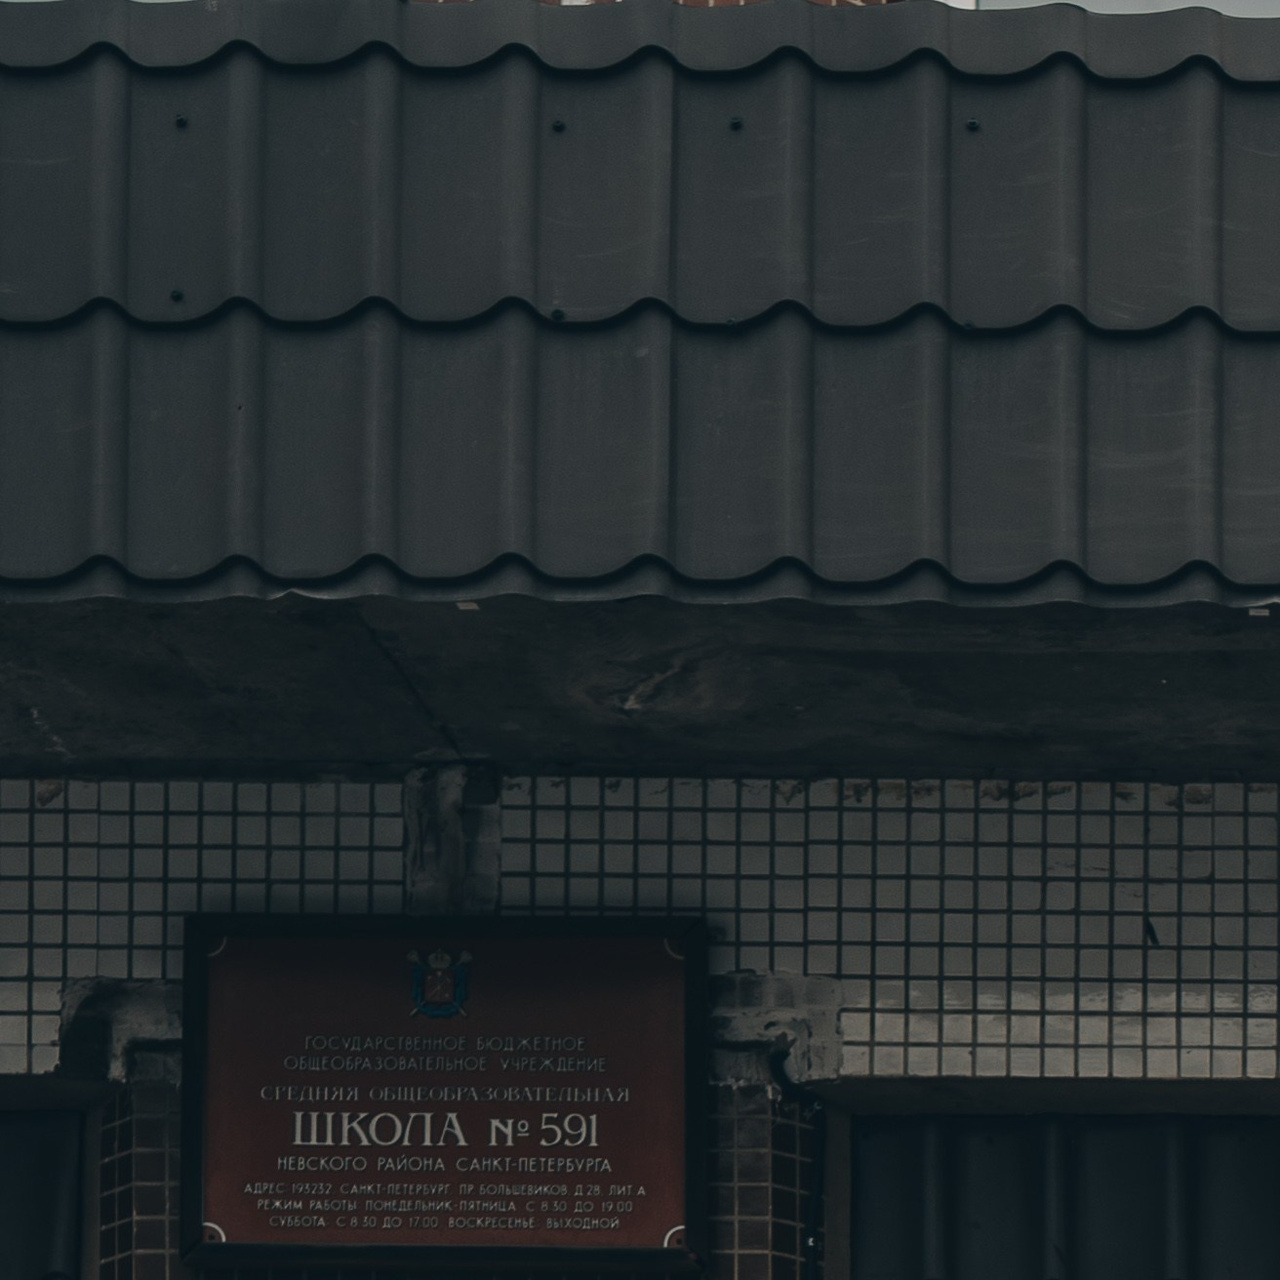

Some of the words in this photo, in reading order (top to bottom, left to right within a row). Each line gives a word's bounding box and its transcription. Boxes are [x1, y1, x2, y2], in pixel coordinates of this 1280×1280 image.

[304, 1035, 467, 1051] ГОСУДАРСТВЕННОЕ
[476, 1036, 586, 1051] БЮДЖЕТНОЕ
[283, 1055, 486, 1072] ОБЩЕОБРАЗОВАТЕЛЬНОЕ
[500, 1056, 606, 1072] УЧРЕЖДЕНИЕ
[260, 1085, 359, 1103] СРЕДНЯЯ
[369, 1086, 630, 1103] ОБЩЕОБРАЗОВАТЕЛЬНАЯ
[292, 1111, 469, 1146] ШКОЛА
[539, 1112, 600, 1147] 591
[277, 1155, 367, 1171] НЕВСКОГО
[377, 1154, 445, 1171] РАЙОНА
[456, 1157, 612, 1173] САНКТ-ПЕТЕРБУРГА
[256, 1198, 303, 1210] РЕЖИМ
[573, 1201, 594, 1213] ДО
[382, 1216, 402, 1229] ДО
[546, 1216, 620, 1230] ВЫХОДНОЙ
